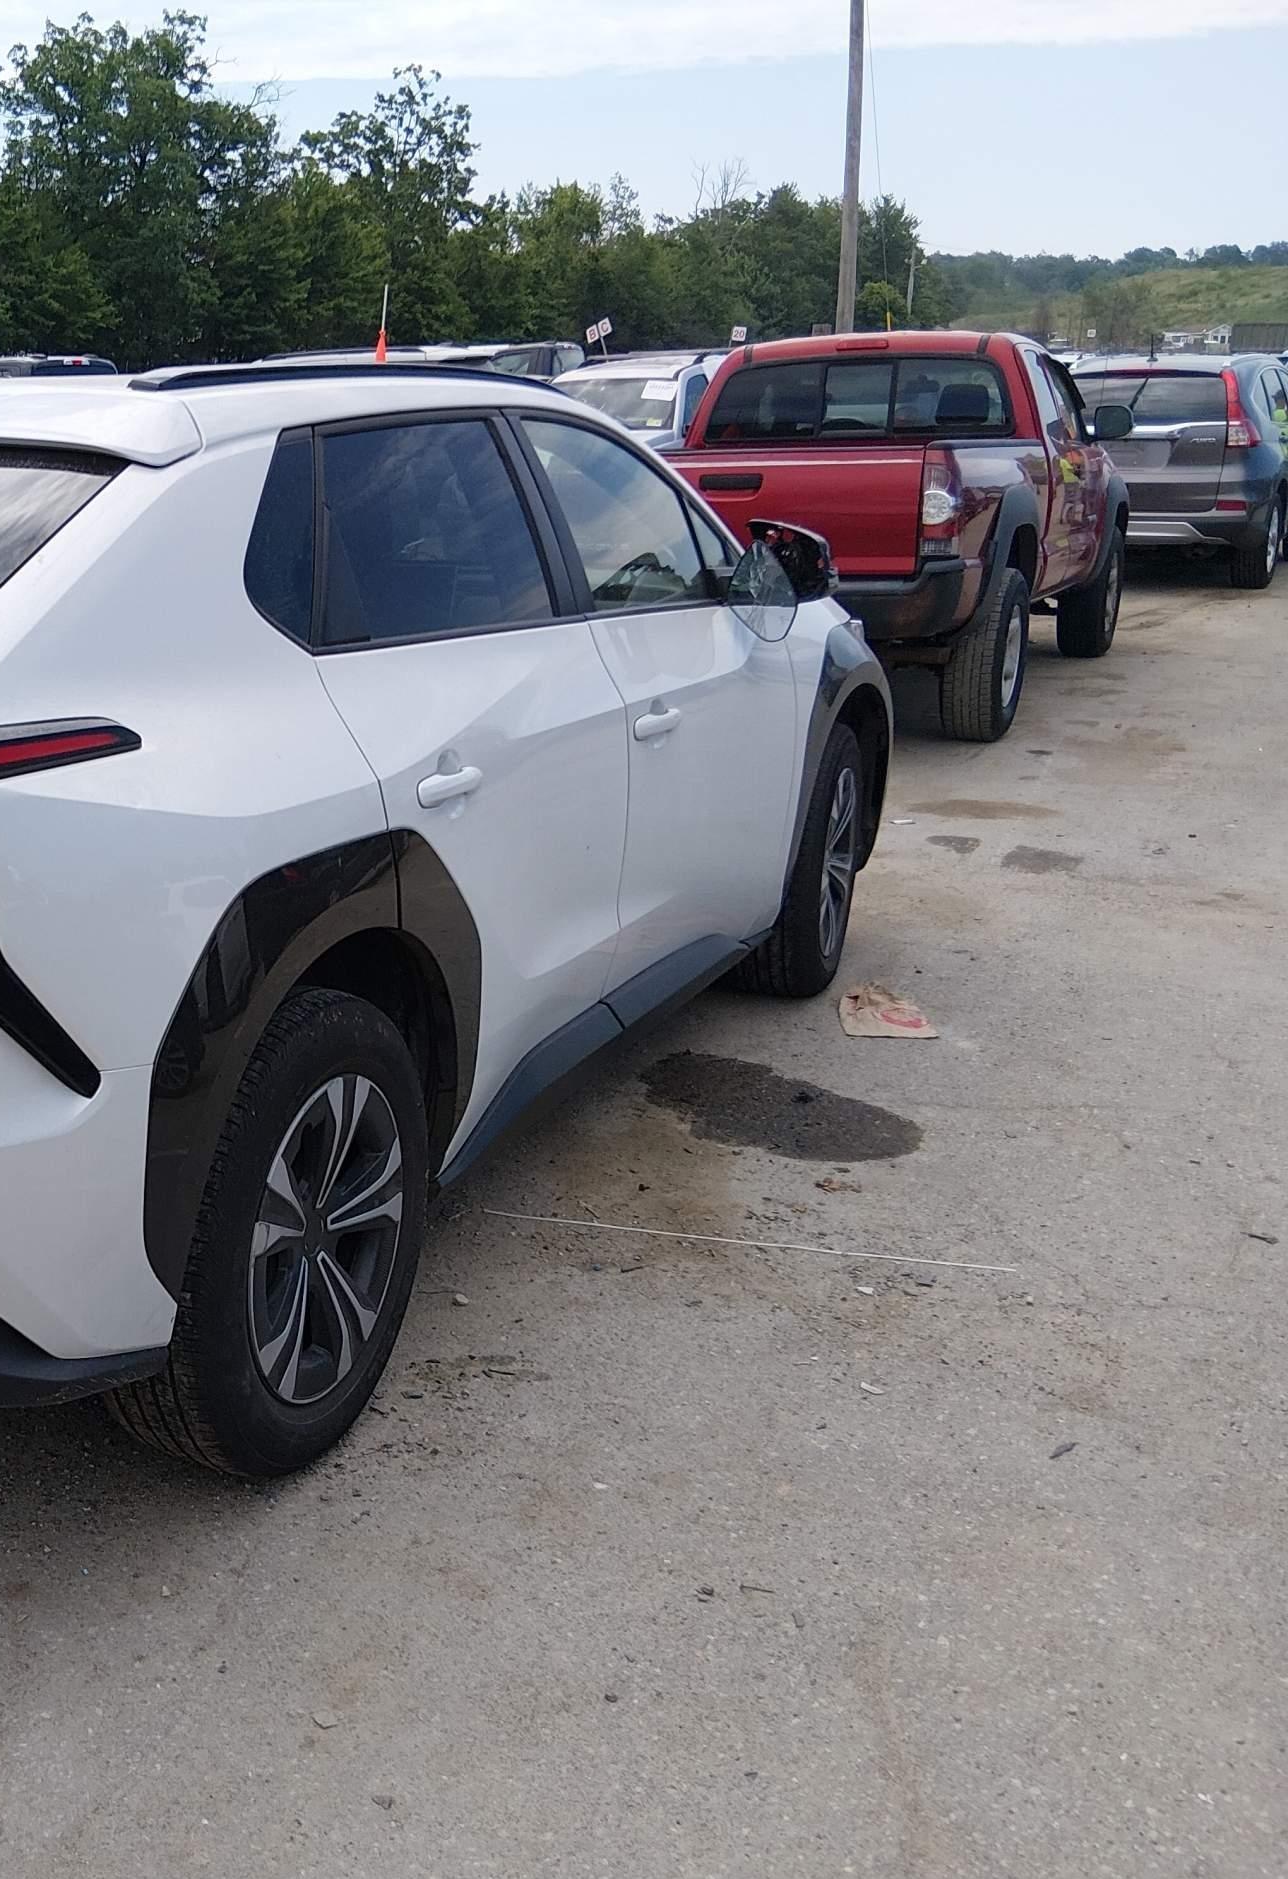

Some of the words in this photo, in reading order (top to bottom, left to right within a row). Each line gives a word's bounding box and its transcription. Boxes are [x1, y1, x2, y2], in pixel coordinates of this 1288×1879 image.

[588, 328, 597, 341] B
[600, 321, 609, 333] C
[733, 329, 745, 339] 20
